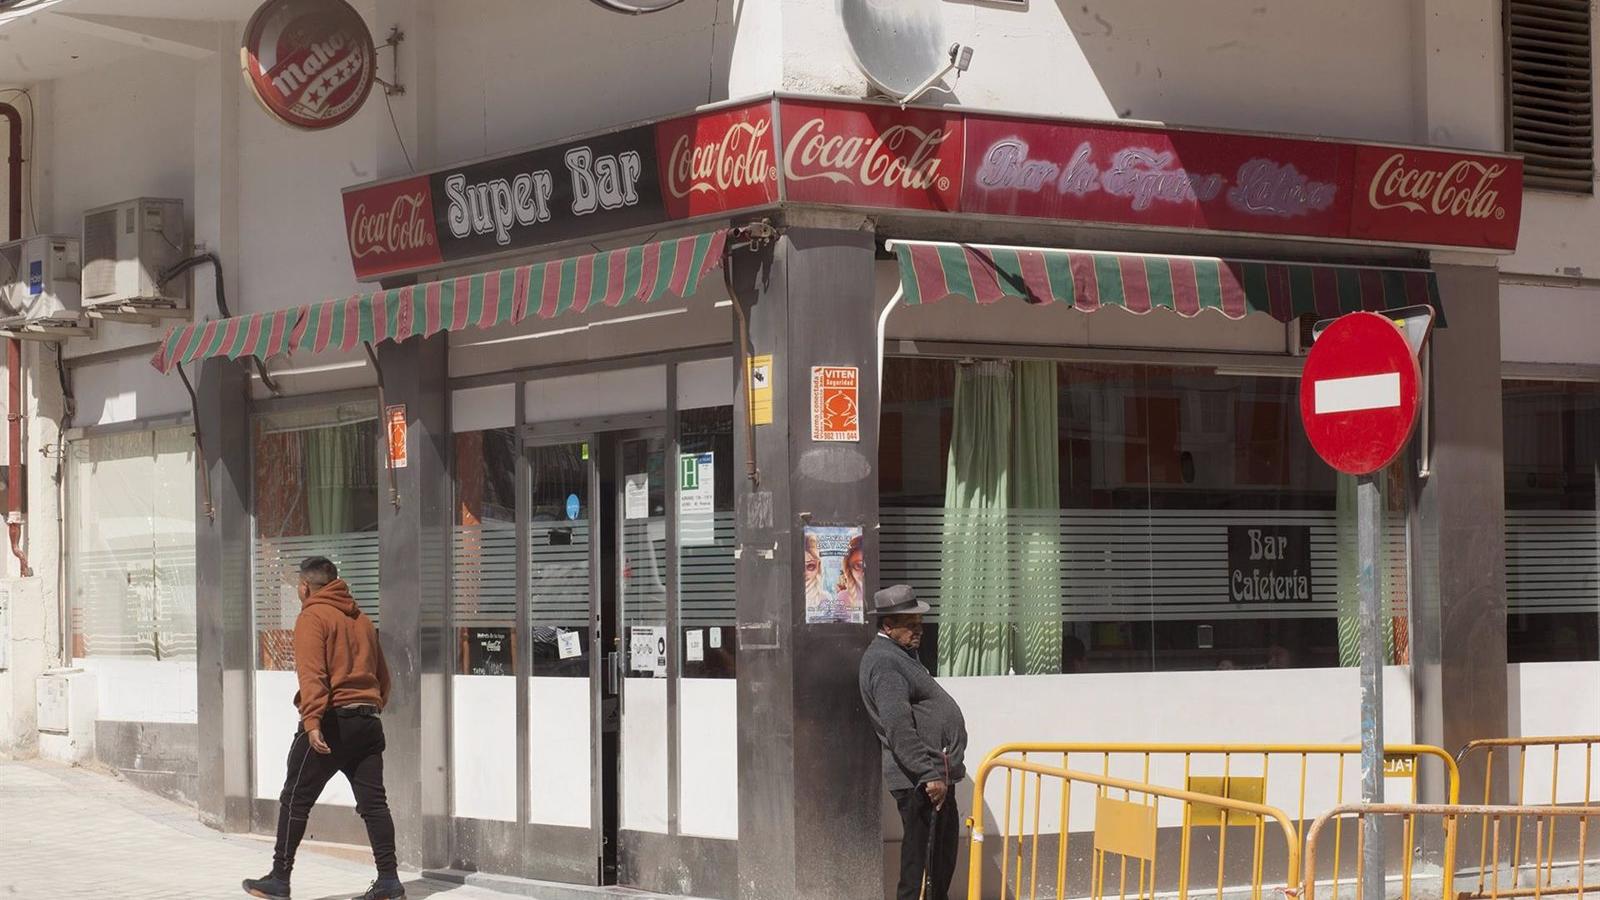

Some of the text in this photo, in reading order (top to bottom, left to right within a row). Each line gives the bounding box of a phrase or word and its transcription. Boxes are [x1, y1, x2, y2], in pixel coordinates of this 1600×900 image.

[271, 30, 350, 98] Maho
[977, 137, 1058, 190] Bar
[445, 145, 641, 246] Super Bar
[825, 369, 855, 379] VITEN
[682, 459, 698, 488] H
[1247, 529, 1287, 560] Bar
